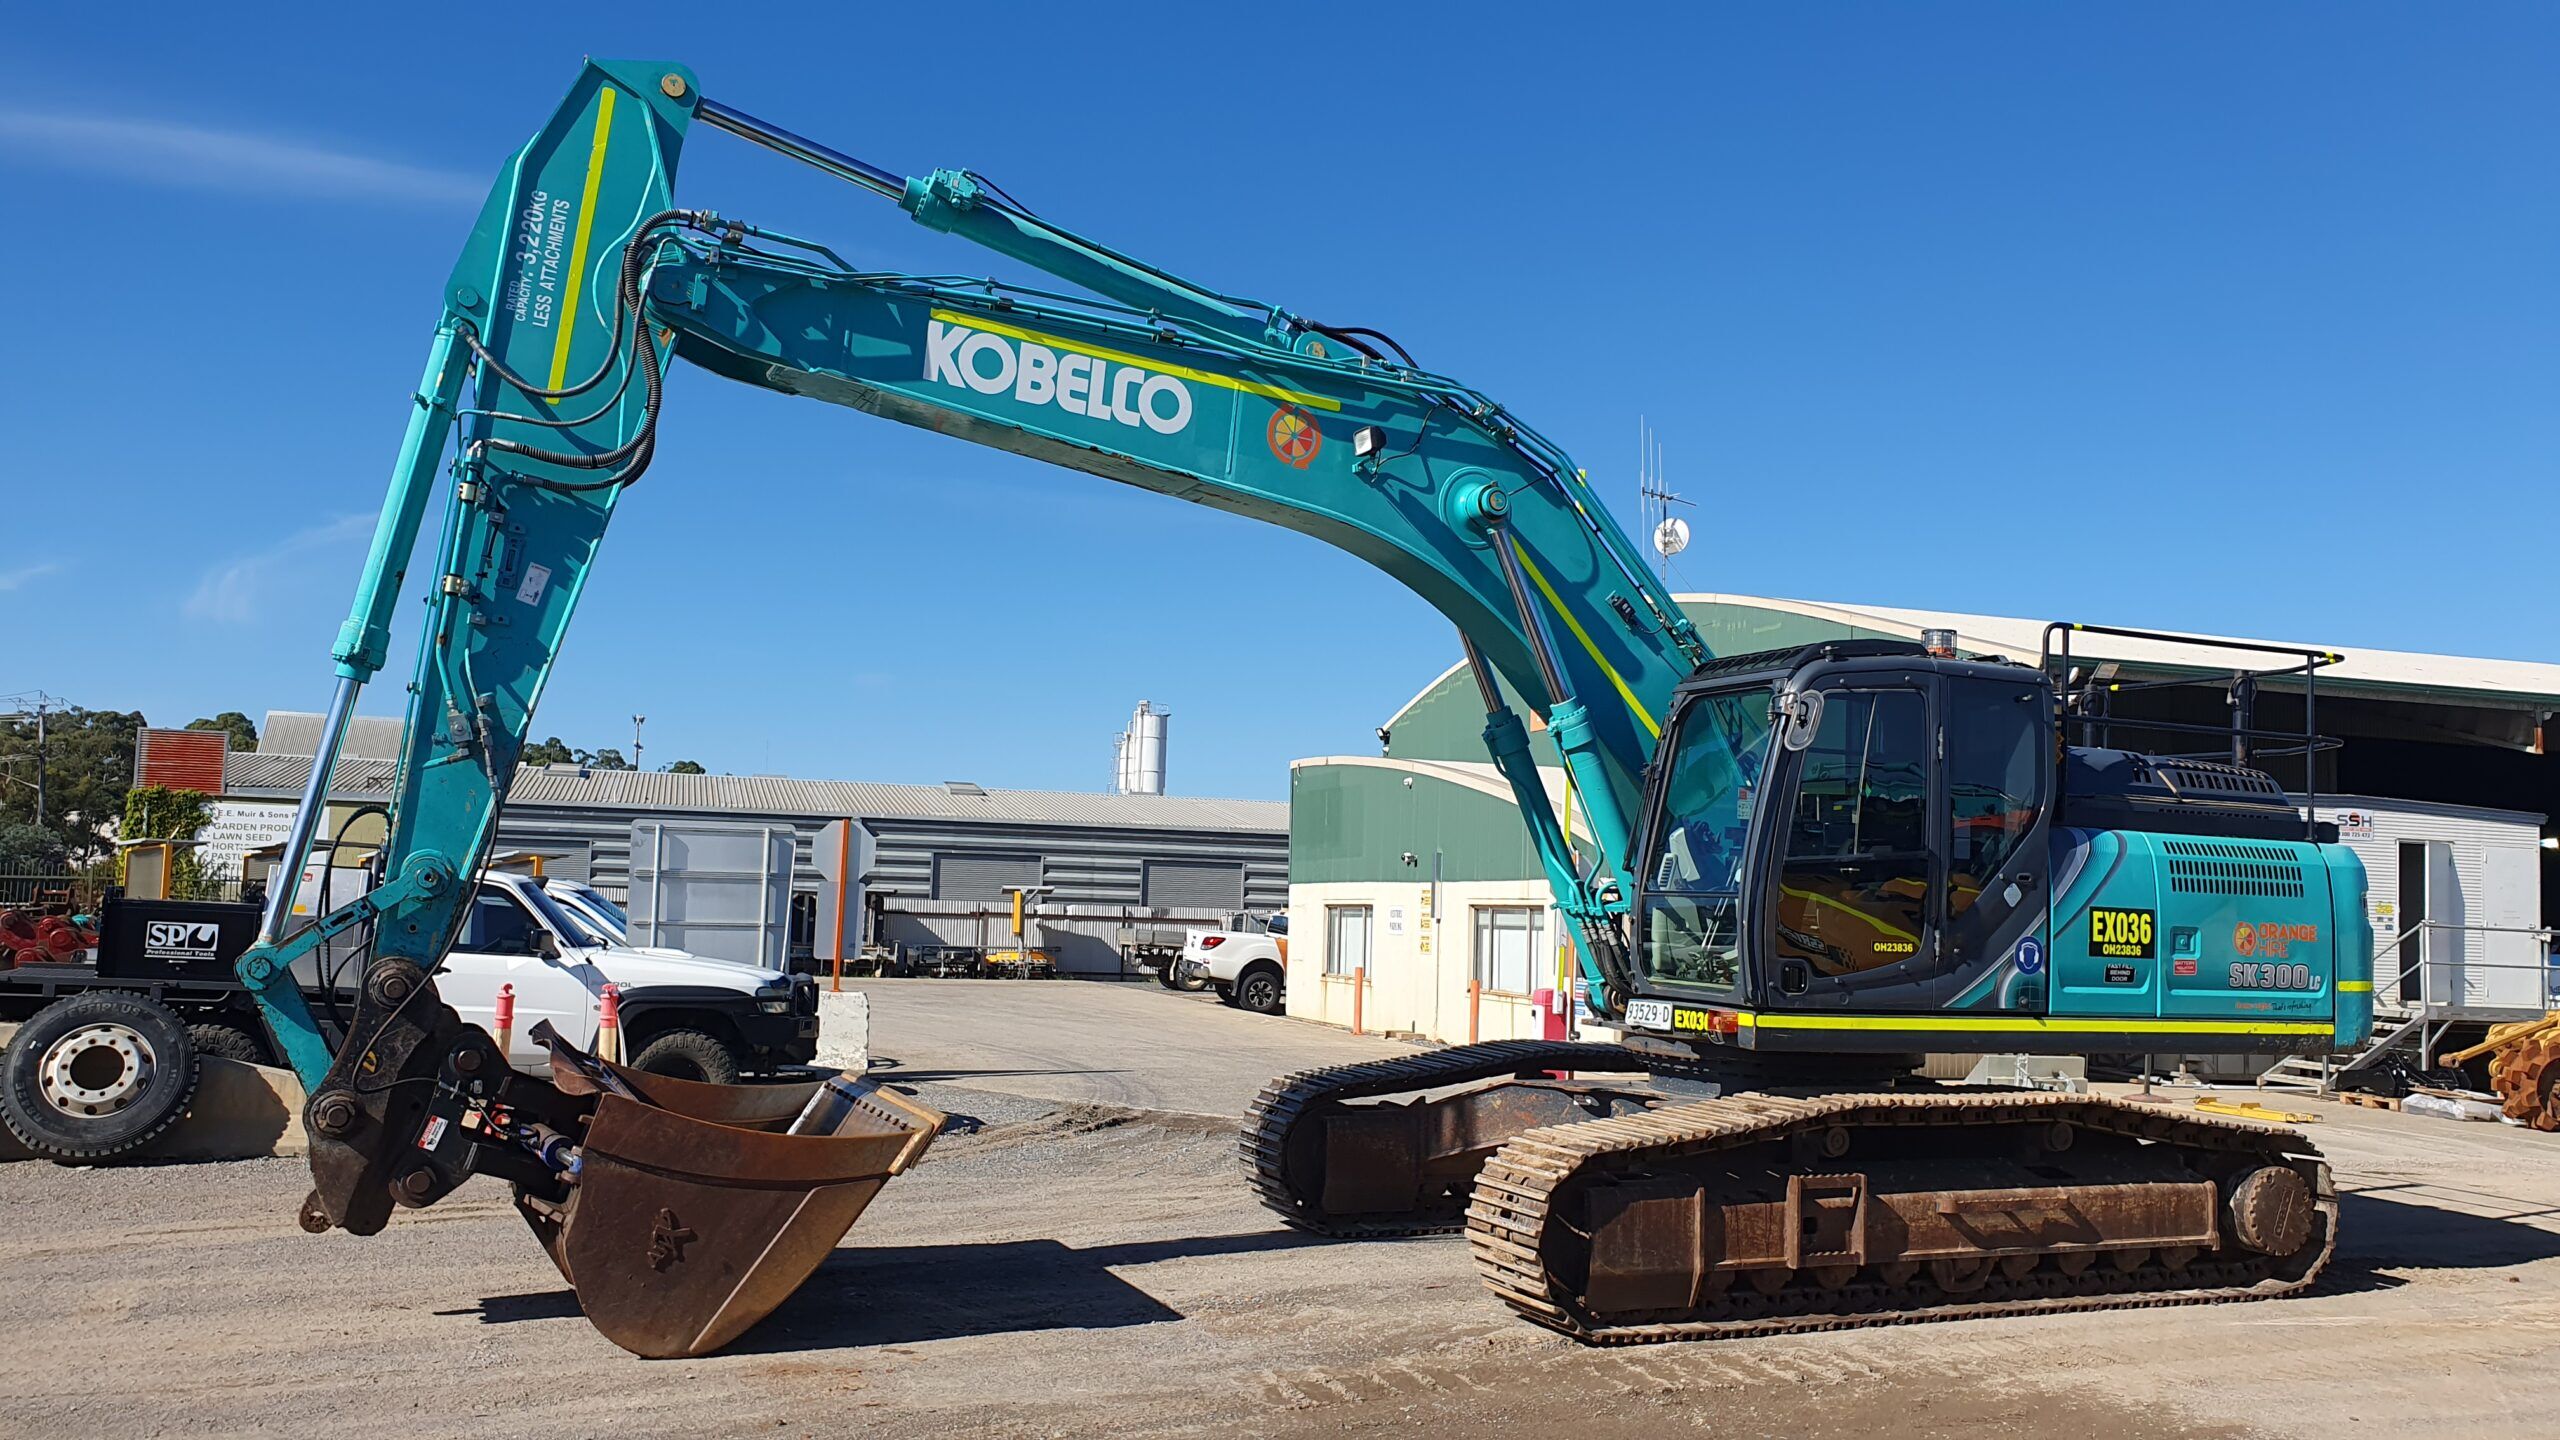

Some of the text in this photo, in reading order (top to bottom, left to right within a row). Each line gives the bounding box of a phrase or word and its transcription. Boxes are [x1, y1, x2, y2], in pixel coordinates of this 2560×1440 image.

[532, 199, 570, 328] LESS ATTACHMENTS
[505, 279, 521, 311] RATED
[923, 320, 1193, 435] KOBELCO
[237, 810, 256, 818] Muir
[267, 811, 289, 819] Sons
[2337, 814, 2373, 827] SSH
[213, 822, 257, 831] GARDEN
[212, 832, 273, 842] LAWN SEED
[211, 852, 243, 861] PASTU
[148, 924, 187, 947] SP
[2092, 910, 2152, 945] EX036
[2258, 922, 2318, 943] ORANGE
[1873, 942, 1914, 953] OH23836
[2102, 943, 2142, 957] OH23836
[2258, 940, 2289, 958] HIRE
